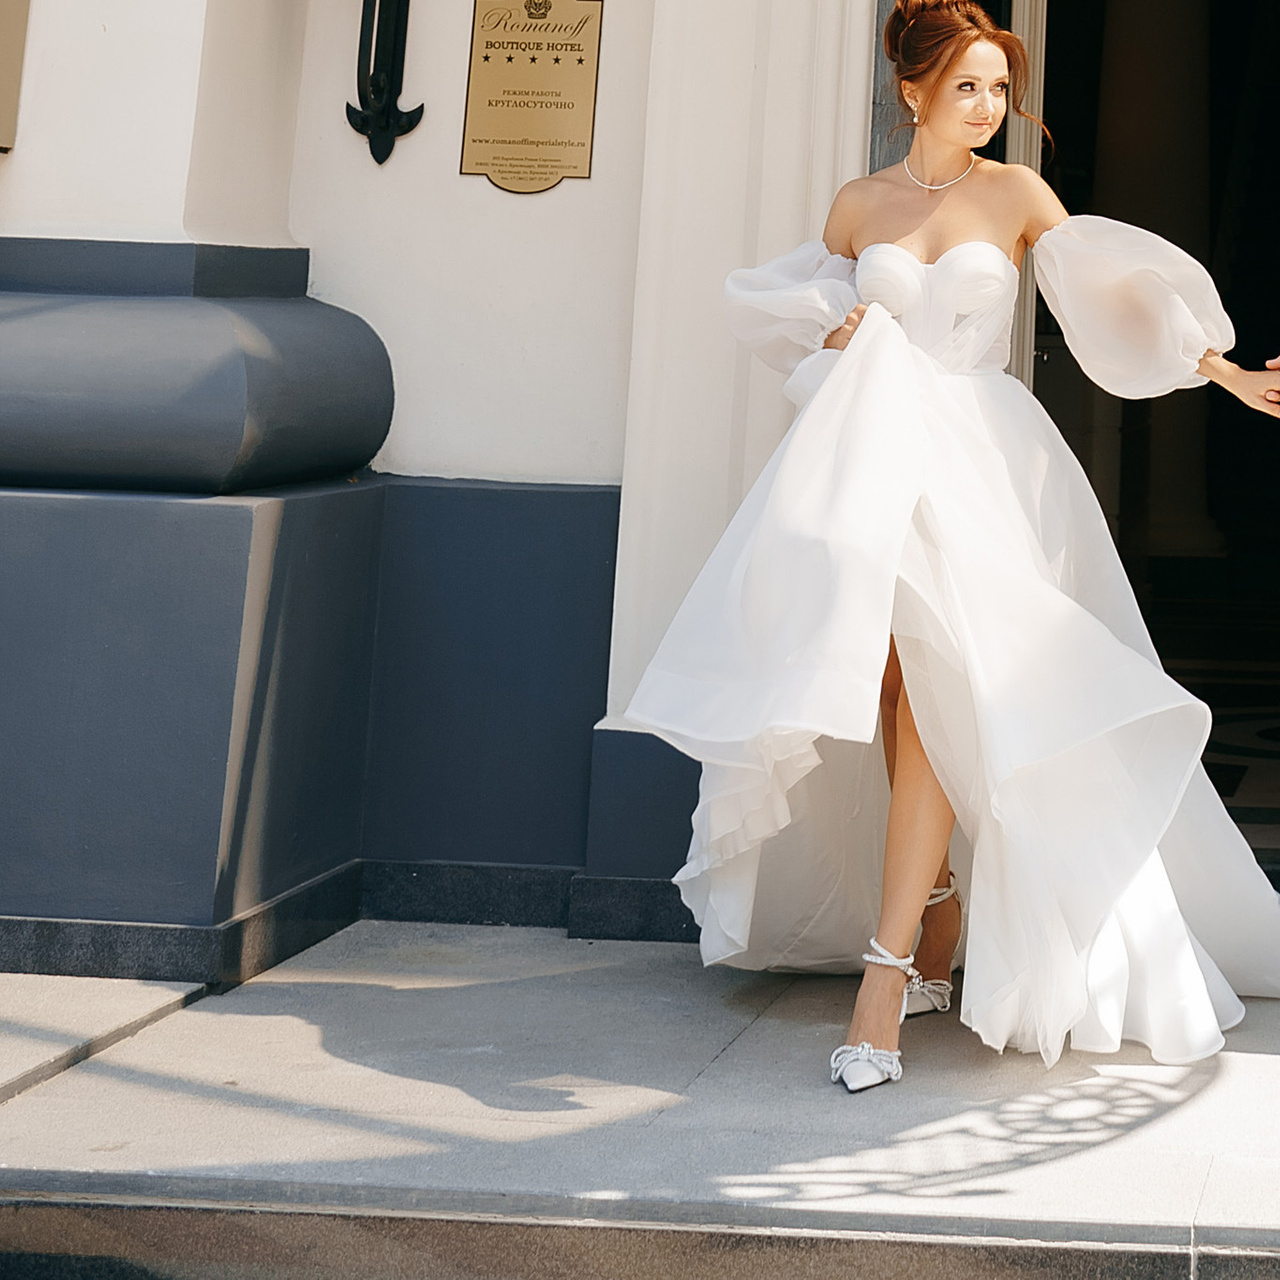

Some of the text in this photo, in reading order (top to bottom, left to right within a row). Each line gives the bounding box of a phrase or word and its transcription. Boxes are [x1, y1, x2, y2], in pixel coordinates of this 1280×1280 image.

[481, 7, 594, 41] Romanoff
[485, 41, 584, 52] BOUTIQUE HOTEL
[488, 99, 575, 110] КРУГЛОСУТОЧНО
[471, 138, 586, 149] www.romanoffimperialstyle.ru
